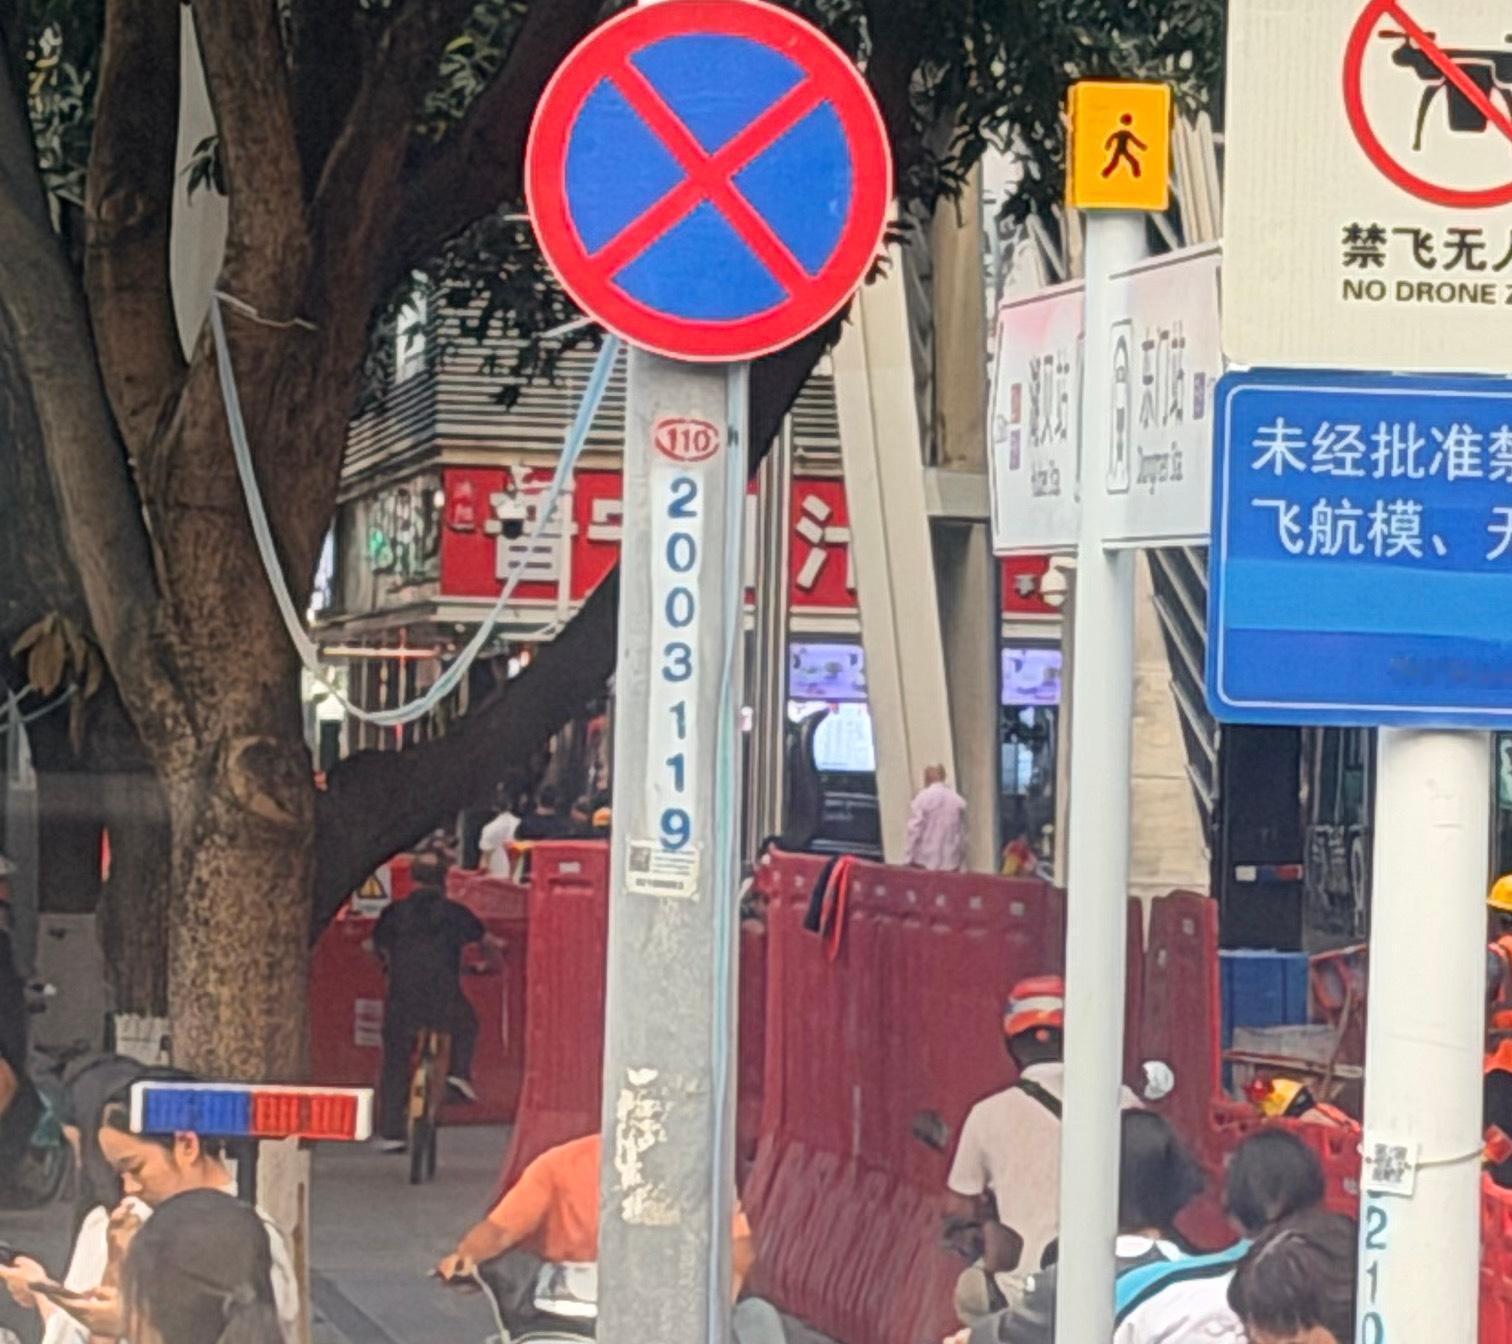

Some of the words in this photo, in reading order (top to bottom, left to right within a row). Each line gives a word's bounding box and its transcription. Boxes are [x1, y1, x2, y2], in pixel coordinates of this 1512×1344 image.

[1343, 278, 1388, 301] NO
[1396, 280, 1496, 306] DRONE
[667, 428, 712, 453] 110
[660, 476, 700, 853] 2003119
